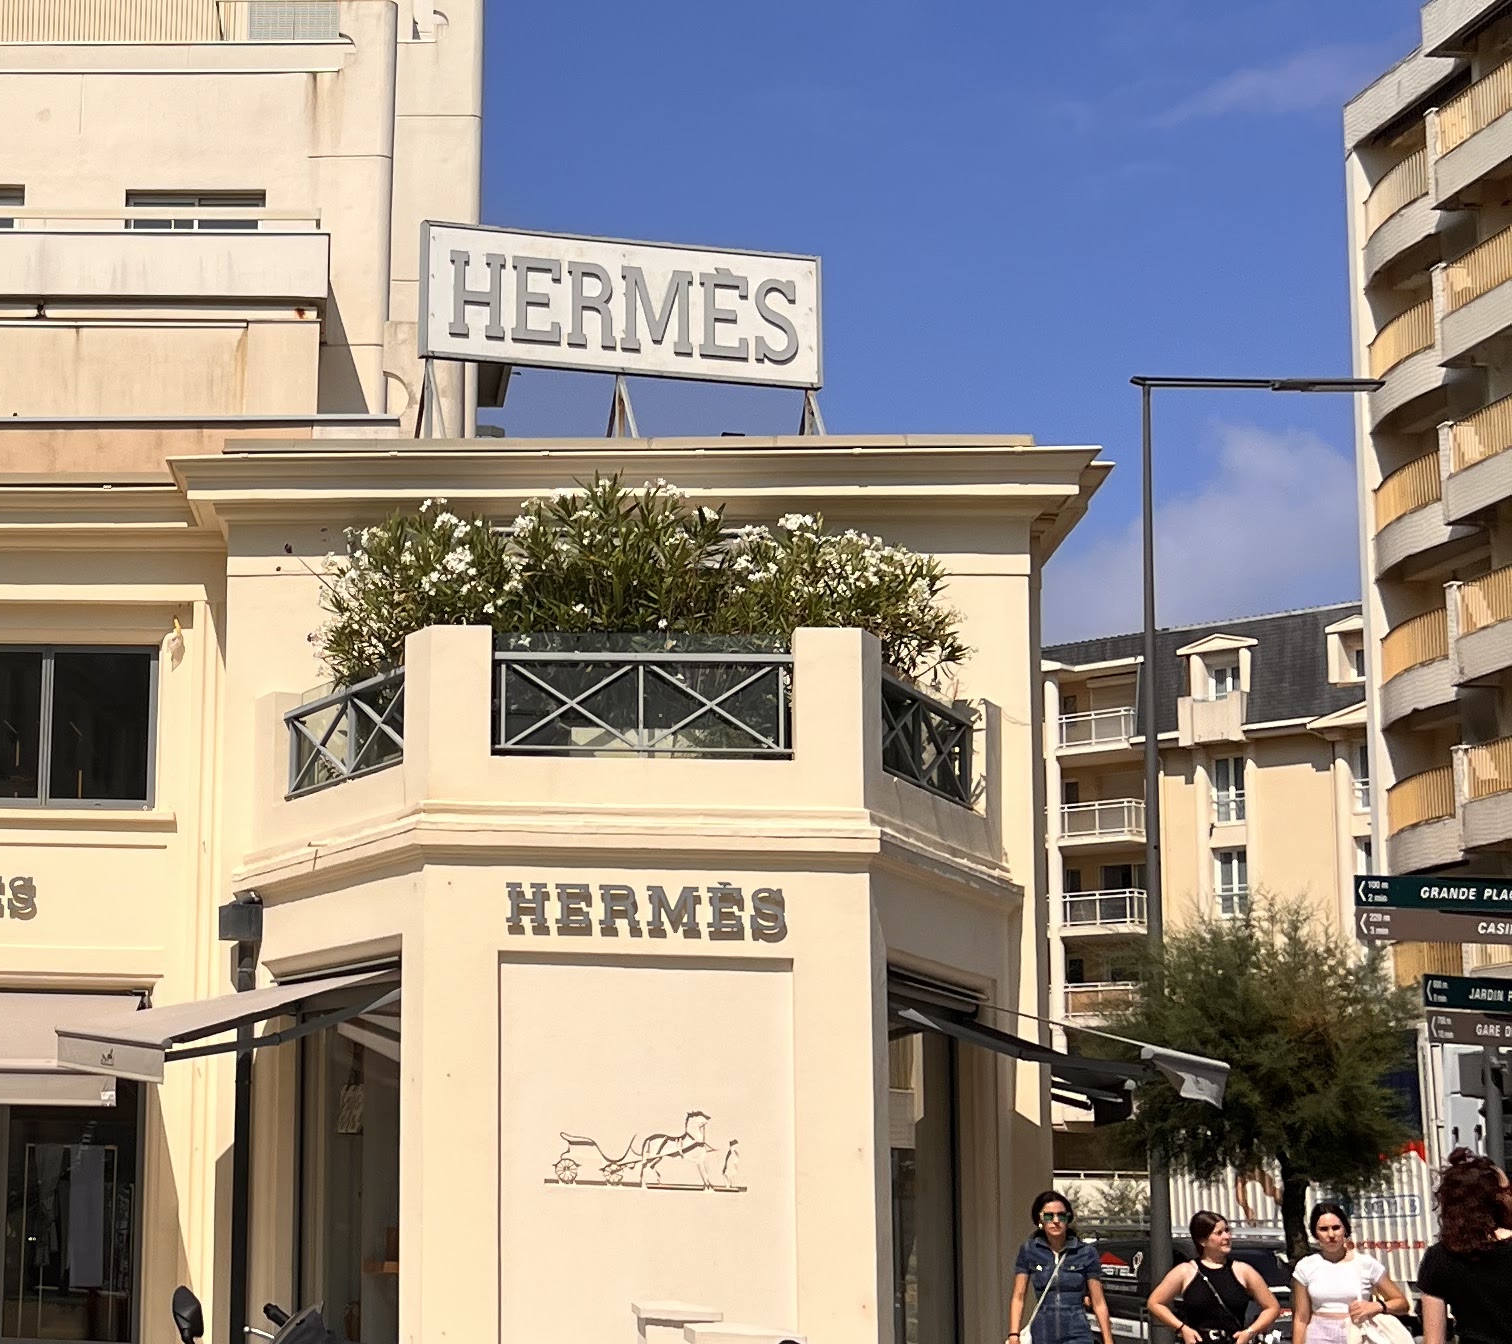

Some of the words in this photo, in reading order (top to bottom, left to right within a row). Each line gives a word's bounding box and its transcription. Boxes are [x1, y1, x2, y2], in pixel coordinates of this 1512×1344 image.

[448, 249, 799, 365] HERMÈS
[1420, 887, 1477, 900] GRANDE
[505, 881, 788, 944] HERMÈS
[1477, 921, 1512, 935] CASI
[1468, 988, 1505, 1002] JARDIN
[1476, 1023, 1501, 1037] GARE
